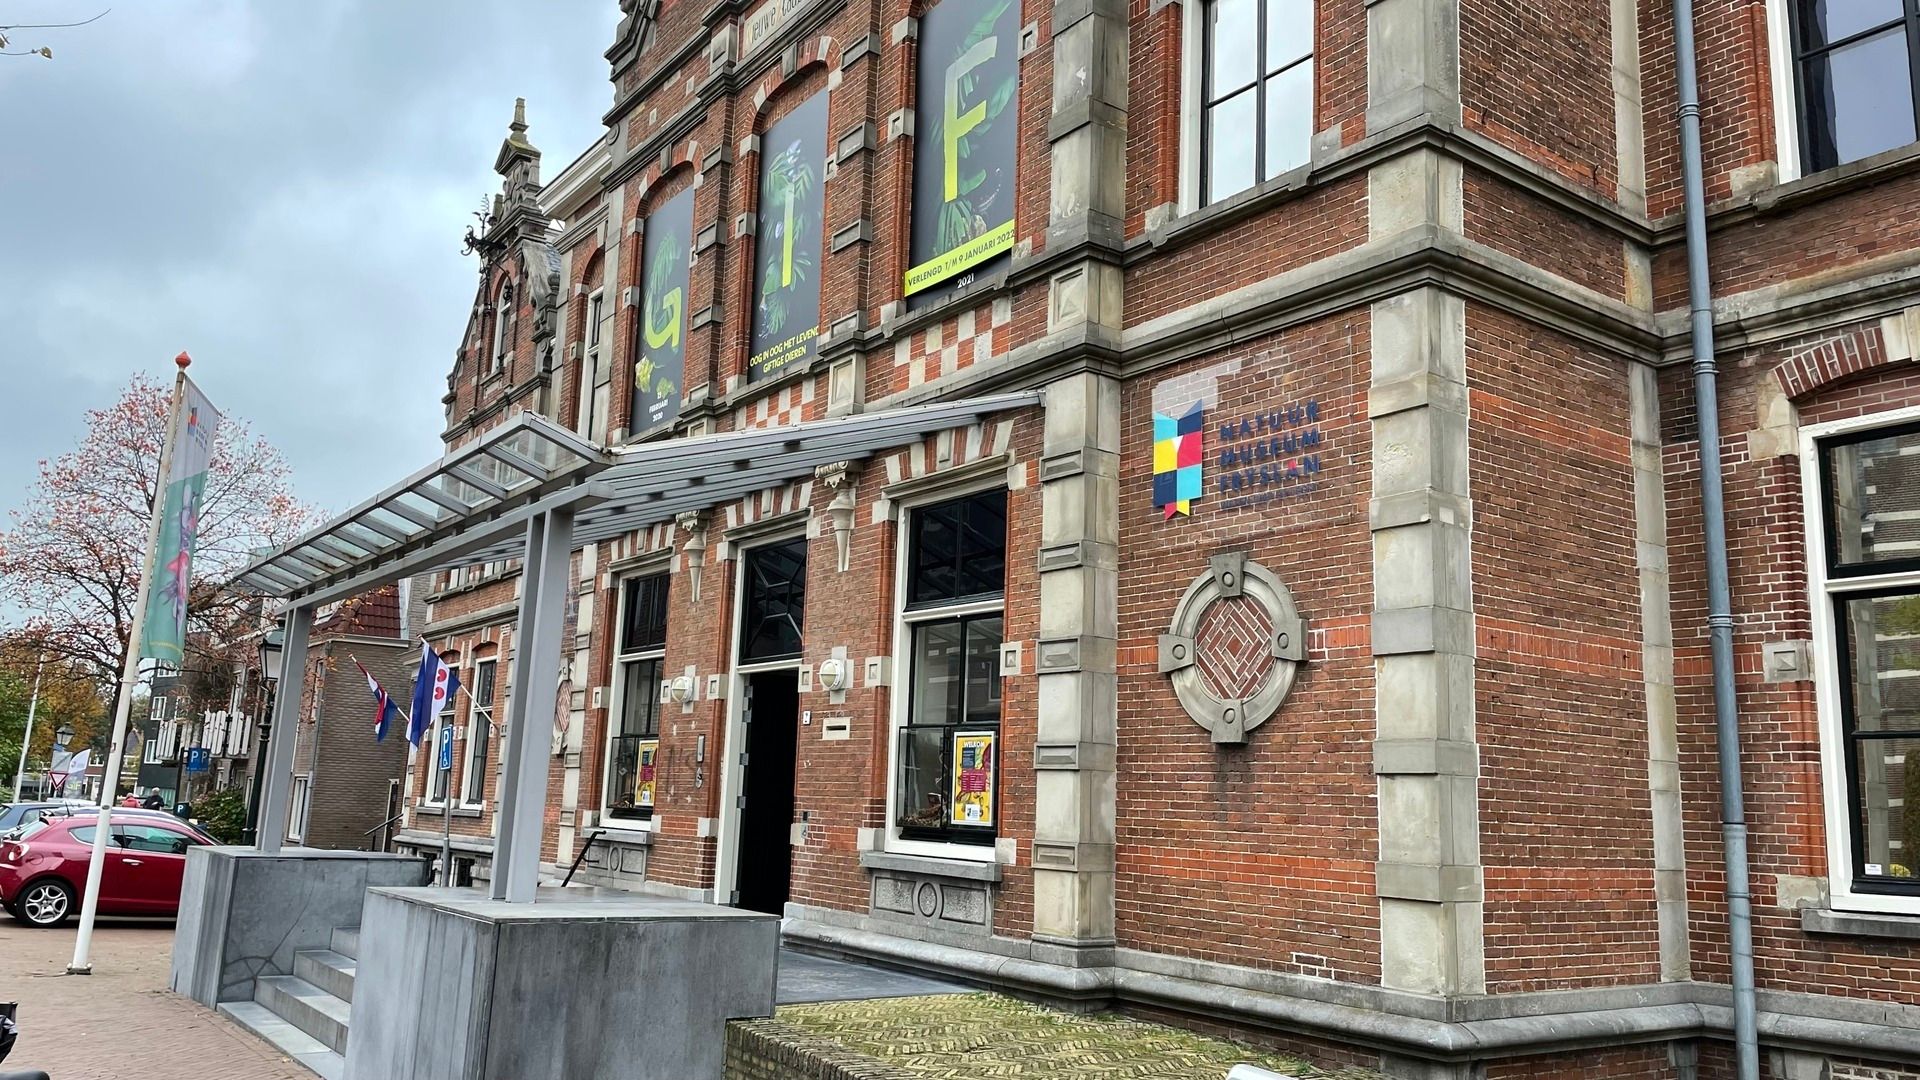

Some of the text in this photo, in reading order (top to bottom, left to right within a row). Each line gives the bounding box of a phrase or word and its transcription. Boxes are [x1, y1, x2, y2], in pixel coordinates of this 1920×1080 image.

[944, 36, 997, 203] F
[908, 229, 1015, 286] VERLENGD T/M 9 JANUARI 2022
[957, 273, 975, 289] 2021
[645, 245, 682, 349] G
[749, 353, 763, 367] OOG
[763, 350, 770, 361] IN
[769, 343, 783, 357] OOG
[763, 345, 807, 373] GIFTIGE DIEREN
[1220, 400, 1318, 439] NATUUR
[1220, 428, 1320, 467] MUSEUM
[443, 730, 449, 752] P
[191, 750, 199, 763] P
[201, 751, 208, 763] P
[177, 804, 184, 813] P
